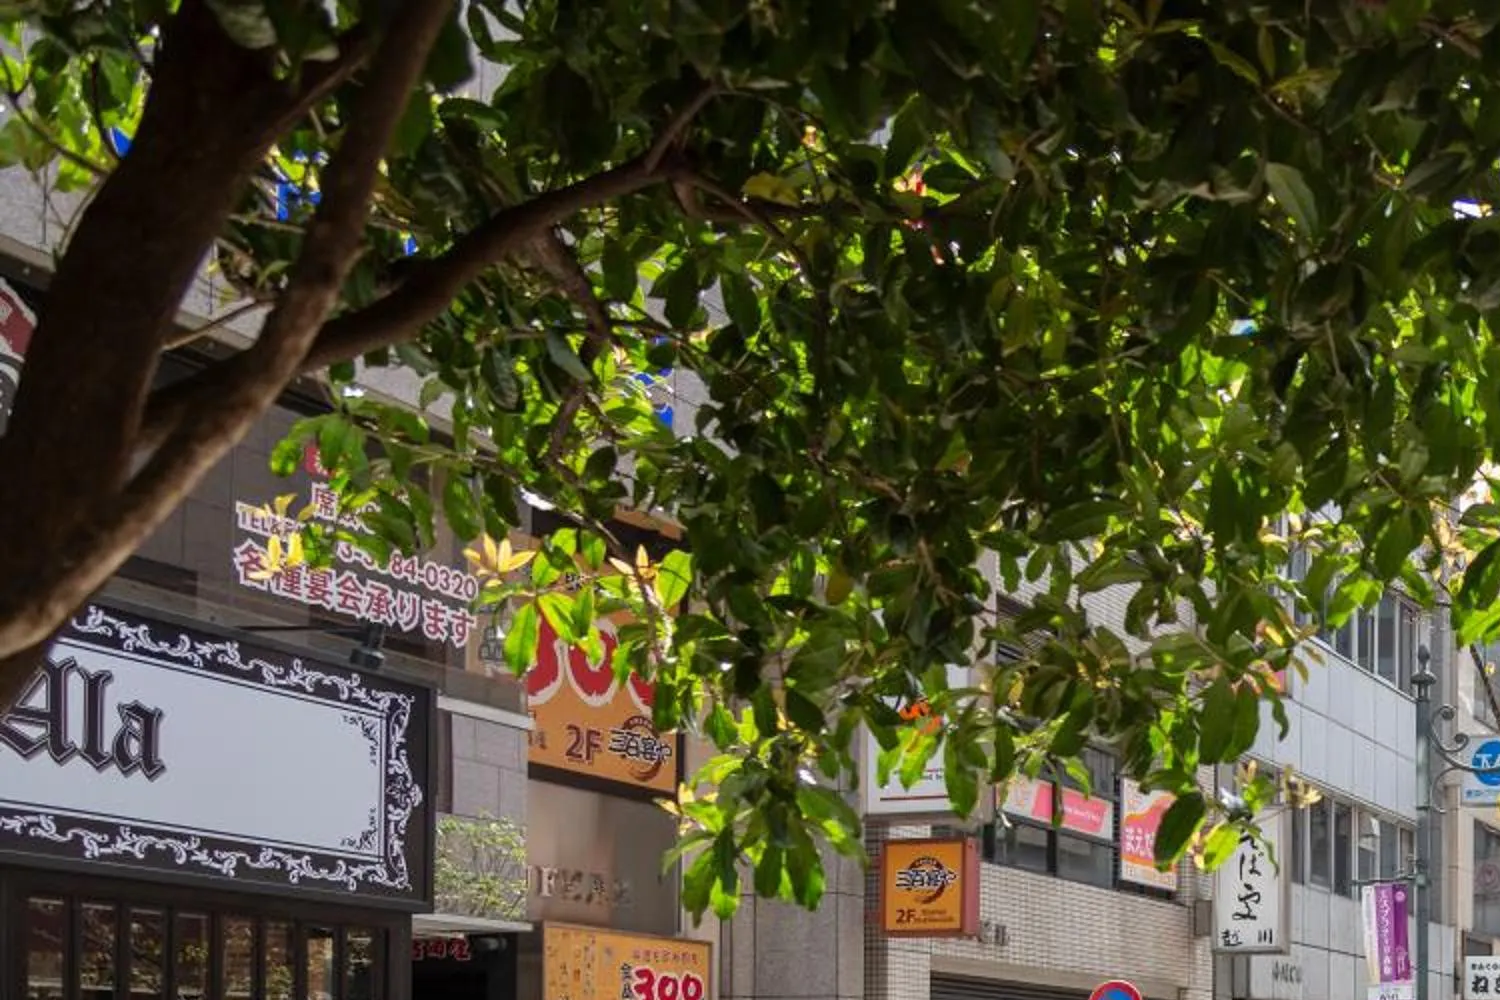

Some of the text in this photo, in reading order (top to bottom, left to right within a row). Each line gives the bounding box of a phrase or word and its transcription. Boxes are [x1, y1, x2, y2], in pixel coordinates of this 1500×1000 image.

[233, 537, 477, 648] 各種宴会承ります
[564, 722, 603, 766] 2F
[895, 908, 917, 924] 2F
[1221, 928, 1273, 947] 越川
